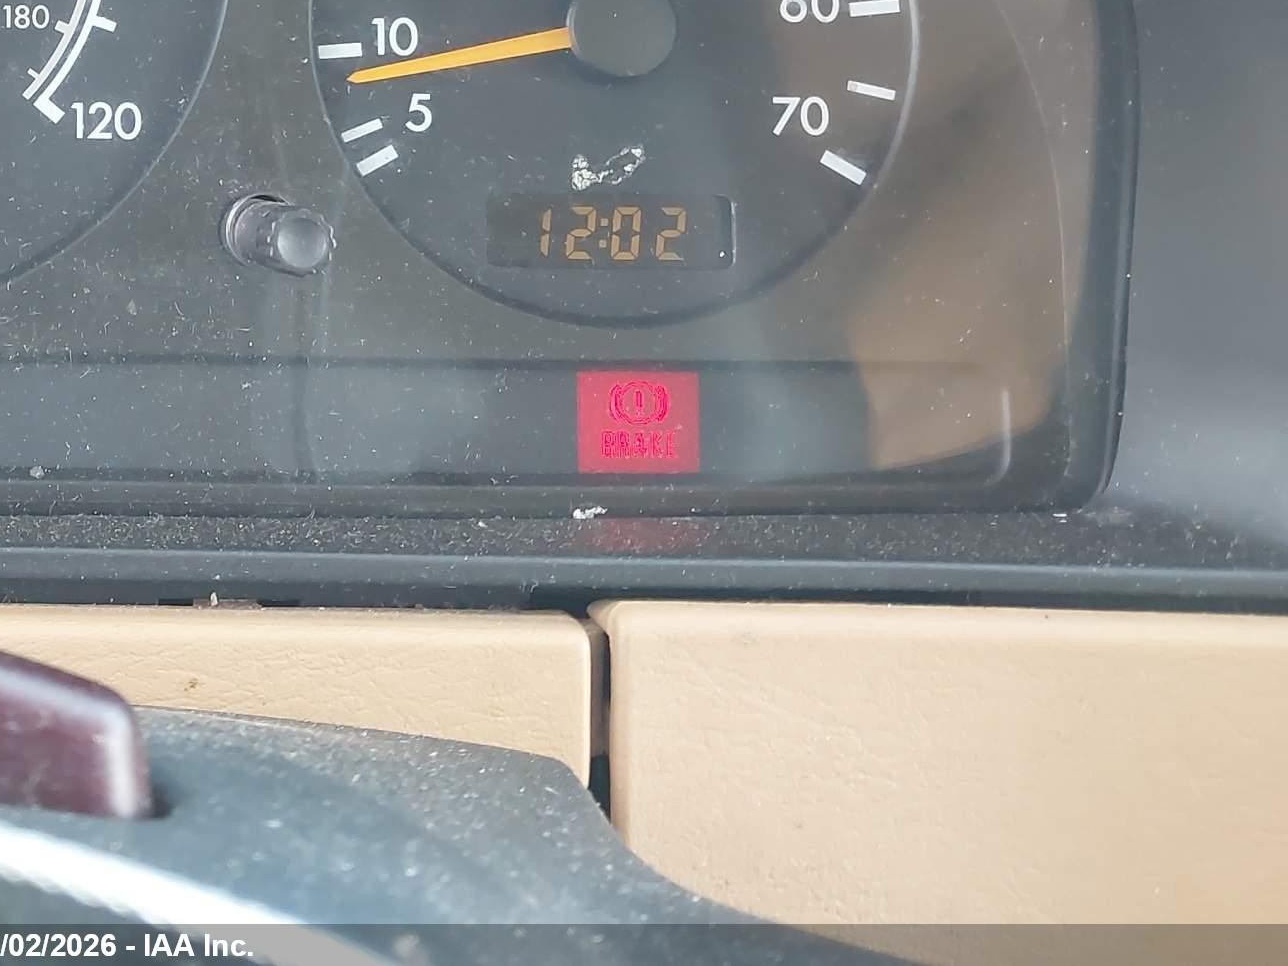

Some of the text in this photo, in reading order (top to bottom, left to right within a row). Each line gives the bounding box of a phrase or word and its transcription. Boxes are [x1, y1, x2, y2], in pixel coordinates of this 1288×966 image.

[2, 4, 50, 29] 180
[371, 17, 419, 56] 10
[70, 101, 142, 140] 120
[405, 93, 433, 132] 5
[772, 96, 829, 136] 70
[542, 204, 687, 262] 12:02
[600, 430, 680, 459] BRAKE
